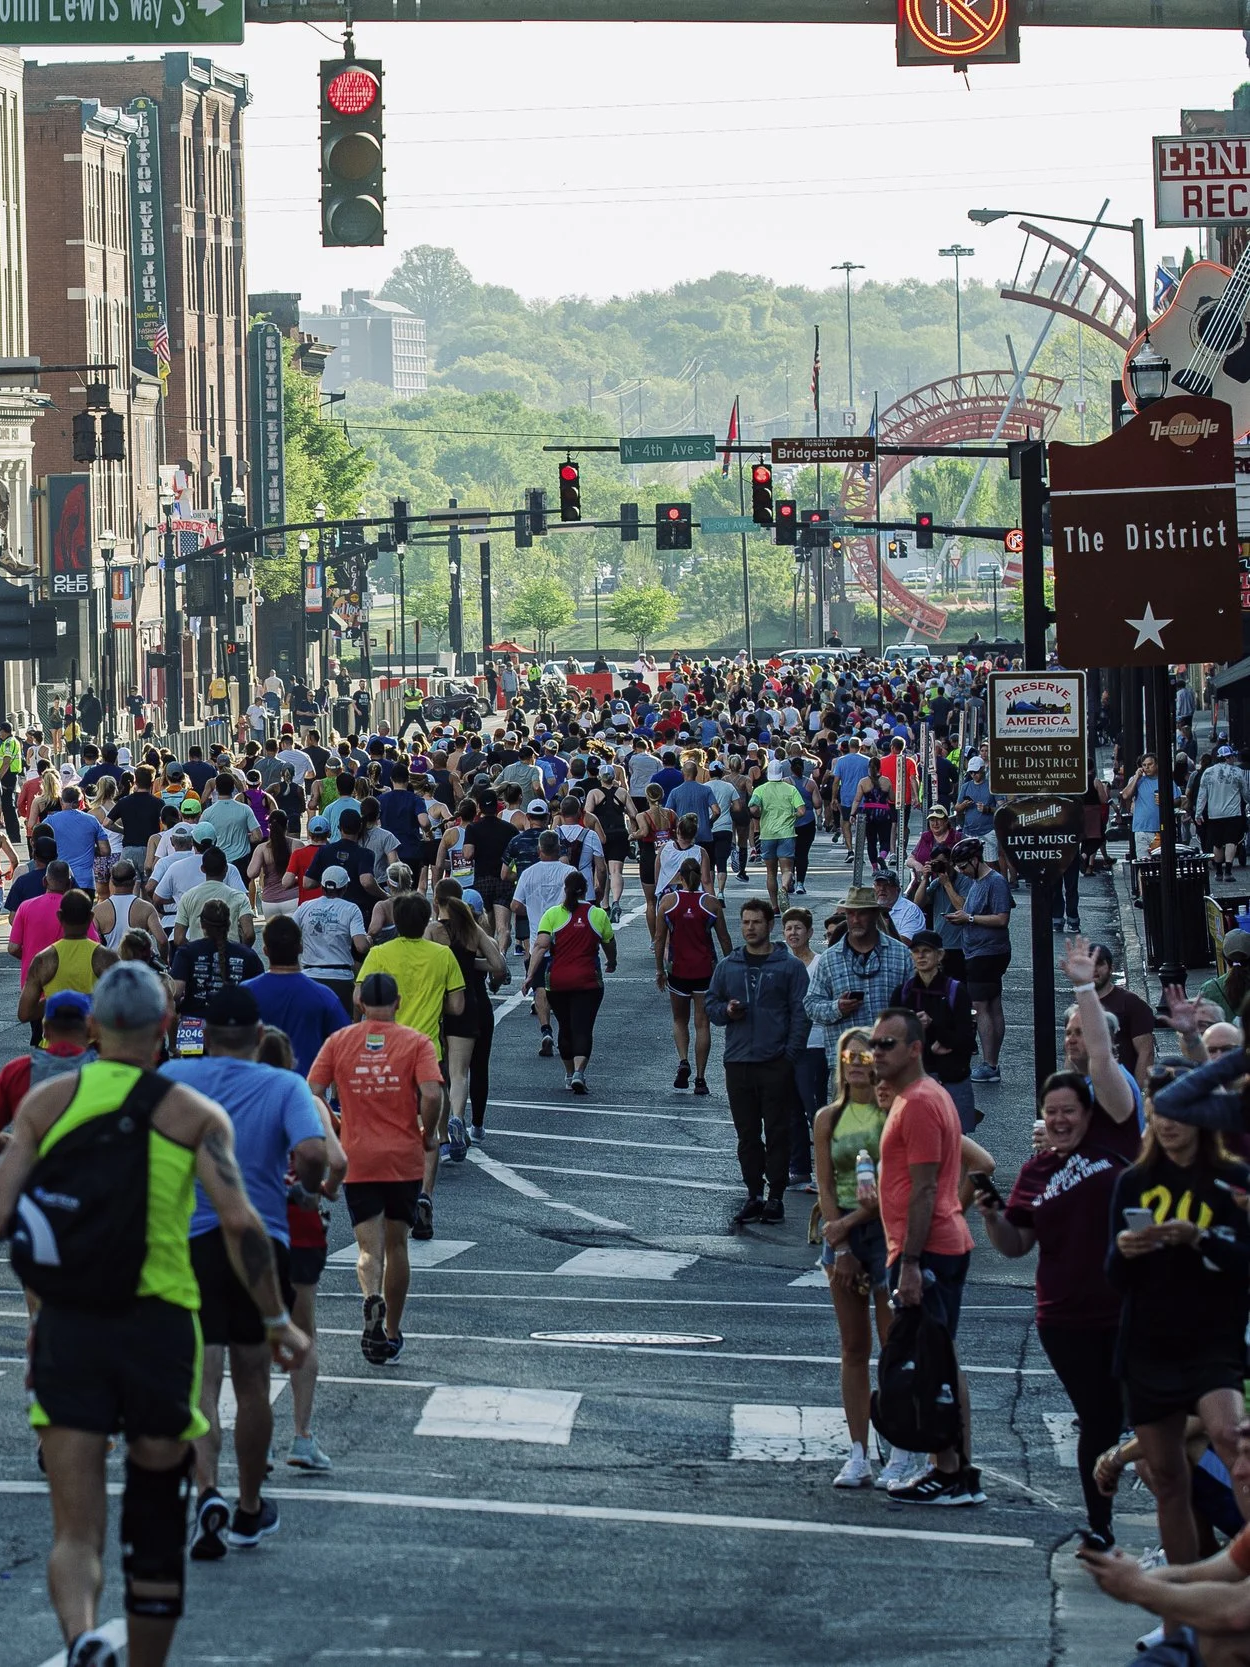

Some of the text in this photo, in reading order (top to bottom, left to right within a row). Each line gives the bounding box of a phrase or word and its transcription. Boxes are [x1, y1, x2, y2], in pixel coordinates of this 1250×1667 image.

[131, 0, 162, 28] Way
[138, 201, 156, 256] EYED
[143, 261, 157, 303] JOE
[1149, 419, 1220, 442] Nashville
[777, 446, 870, 460] Bridgestone Dr
[158, 520, 204, 535] RDNECK
[1063, 519, 1227, 553] The District
[54, 574, 88, 584] OLE
[54, 583, 89, 593] RED
[227, 644, 236, 655] 21
[1004, 682, 1071, 701] PRESERVE
[1006, 716, 1071, 726] AMERICA
[998, 728, 1017, 736] Explore
[1030, 727, 1043, 736] Enjoy
[1057, 726, 1079, 735] Heritage
[997, 756, 1079, 769] THE DISTRICT
[1016, 803, 1062, 827] Nashville
[1007, 834, 1077, 846] LIVE MUSIC
[1015, 849, 1063, 860] VENUES
